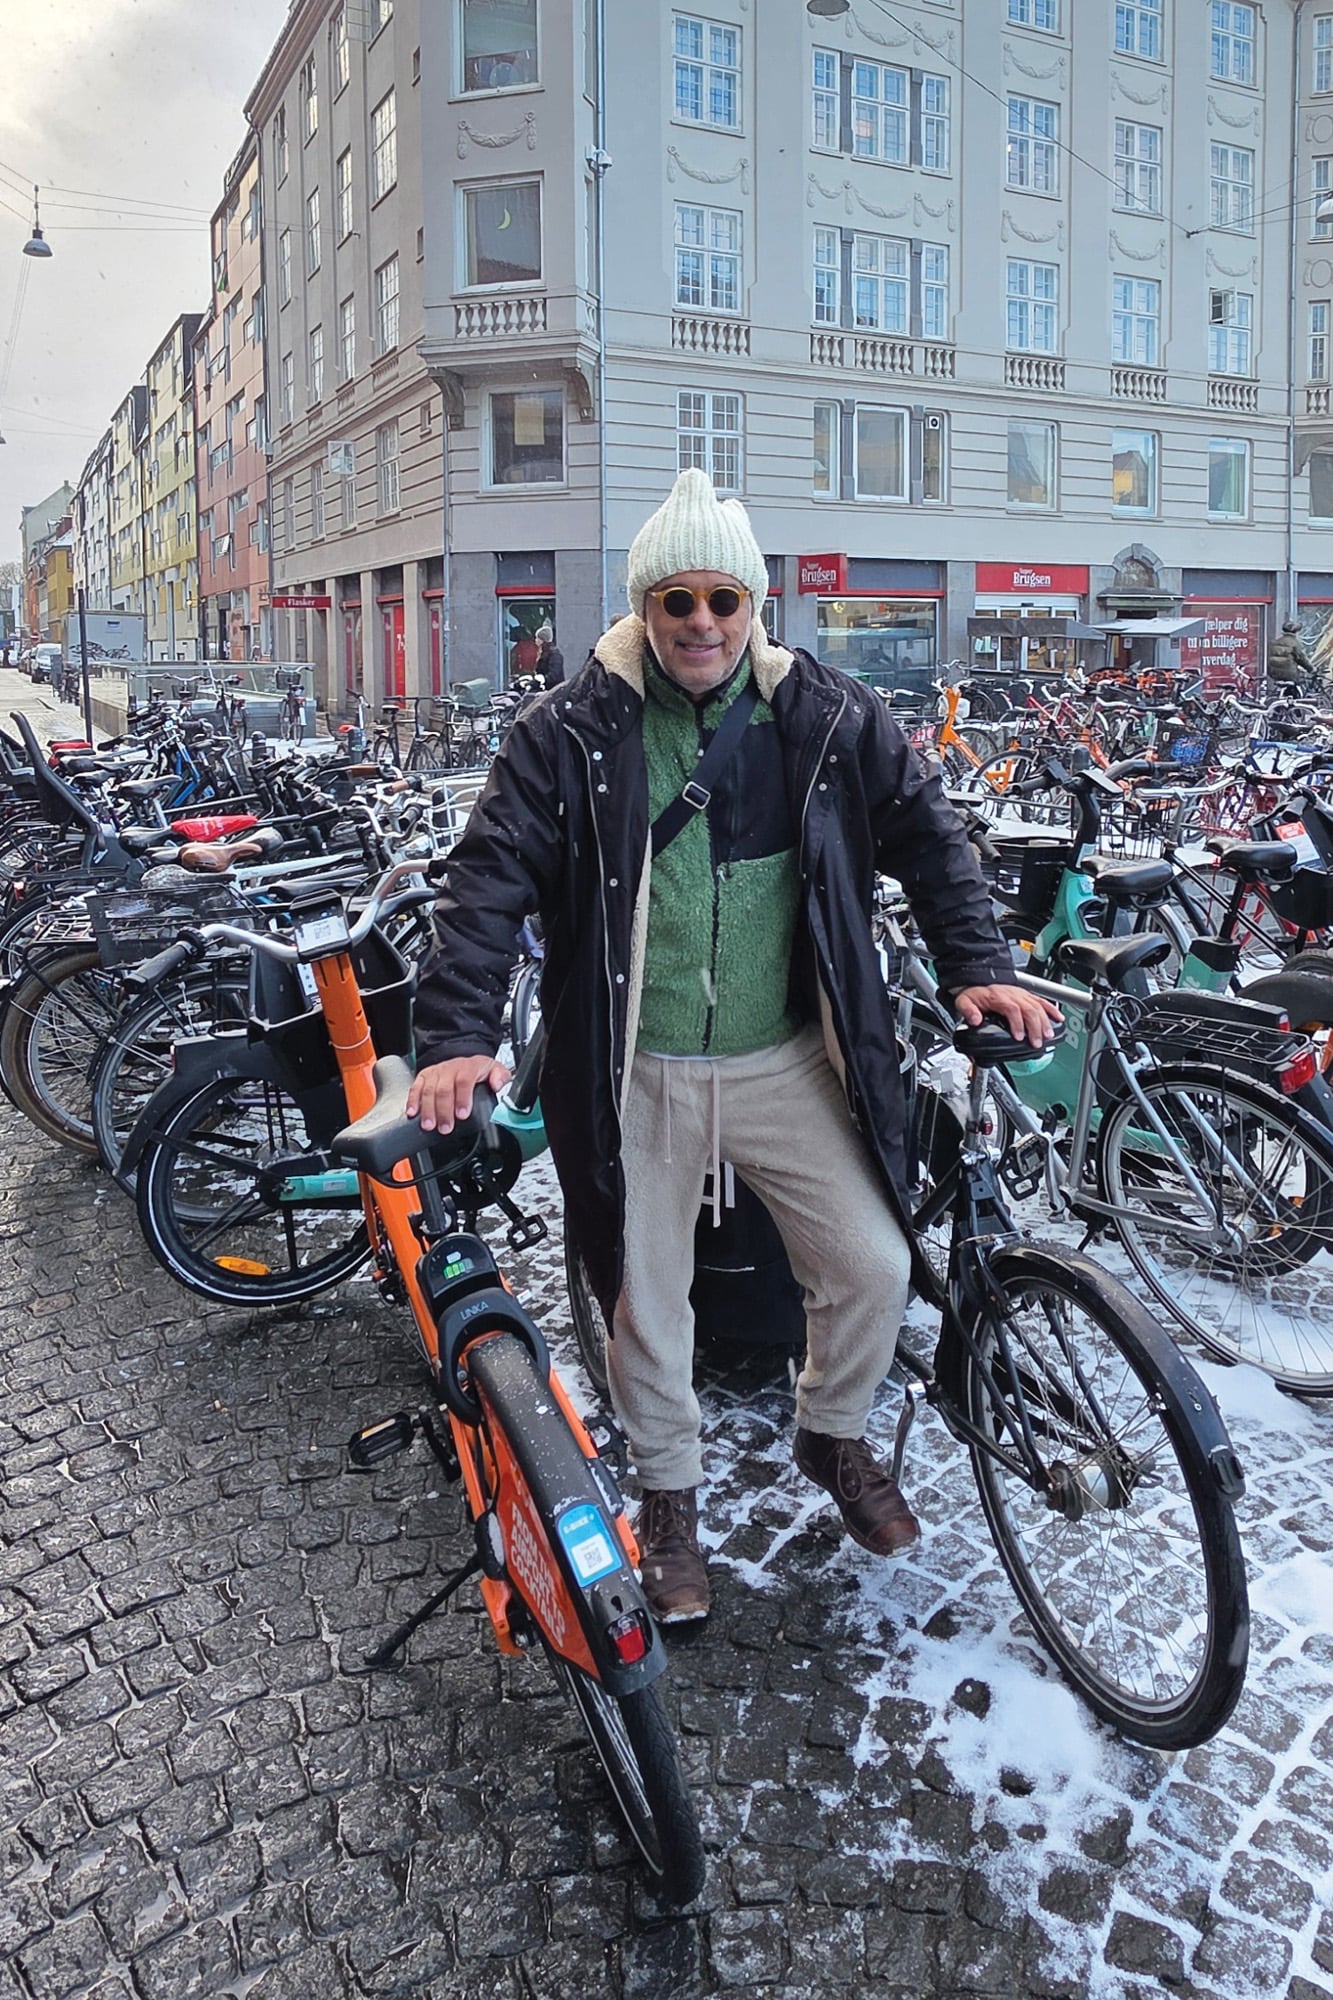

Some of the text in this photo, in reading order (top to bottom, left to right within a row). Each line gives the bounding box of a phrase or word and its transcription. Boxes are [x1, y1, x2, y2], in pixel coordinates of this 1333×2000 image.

[801, 567, 836, 585] Brugsen
[1013, 572, 1051, 588] Brugsen
[1234, 617, 1248, 633] dig
[1211, 634, 1248, 651] billigere
[460, 1301, 489, 1320] LINKA
[511, 1501, 538, 1561] FROM
[511, 1524, 550, 1607] AIRPORT
[551, 1596, 566, 1635] TO
[511, 1544, 564, 1648] COCKTAILS
